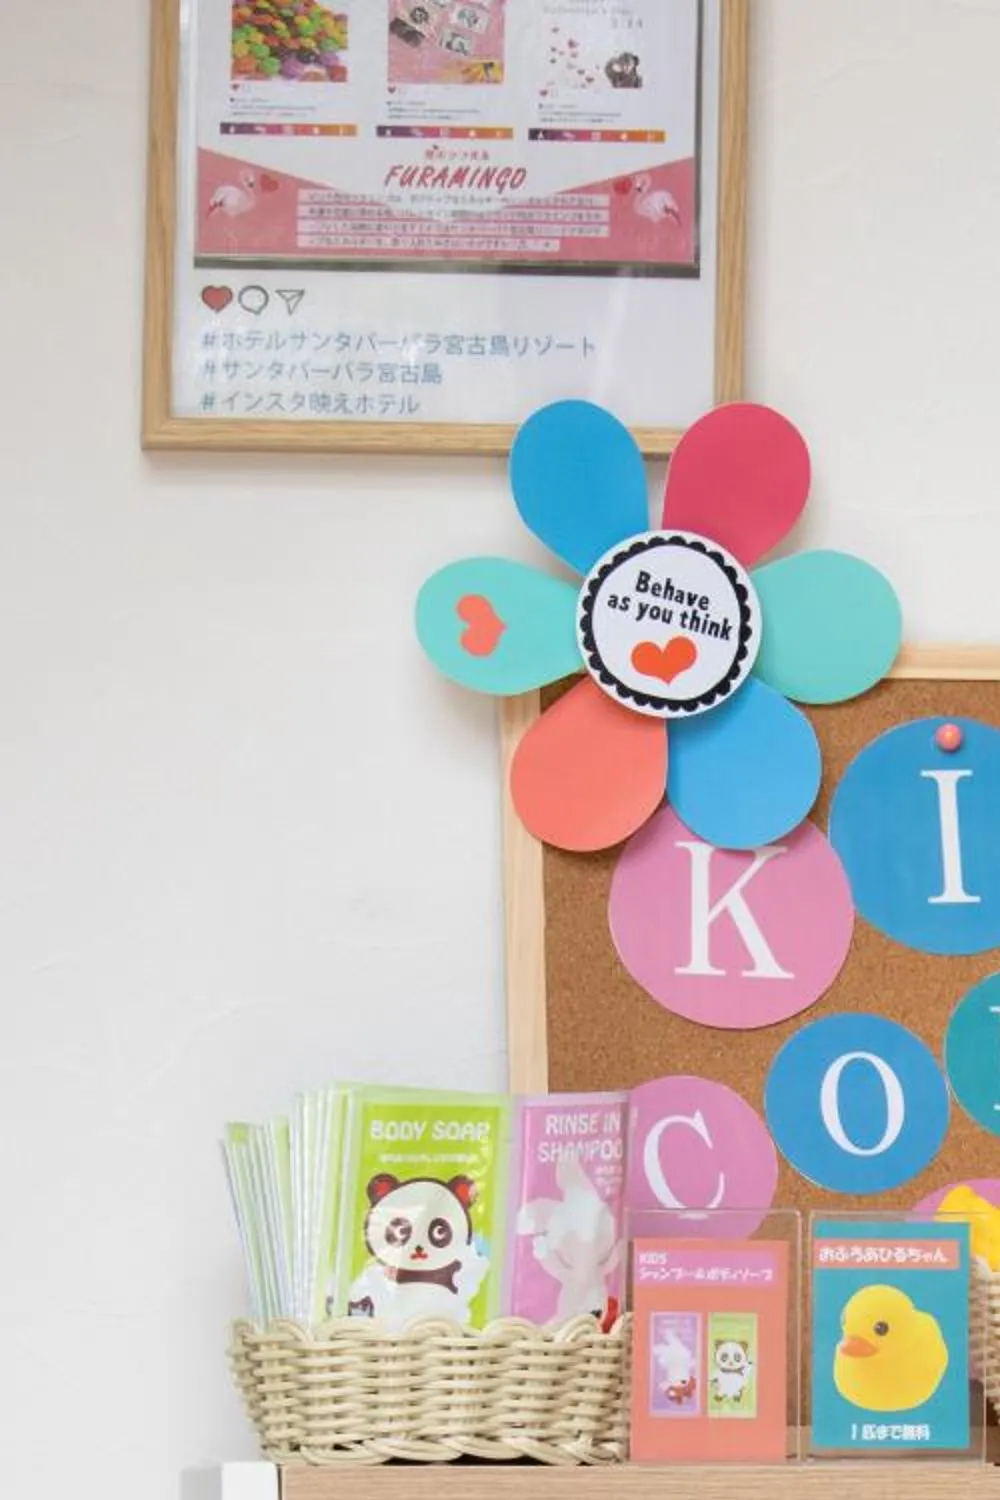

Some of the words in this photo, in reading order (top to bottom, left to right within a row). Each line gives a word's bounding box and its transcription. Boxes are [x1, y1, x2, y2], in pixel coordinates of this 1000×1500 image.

[384, 164, 527, 193] FURAMINGO
[635, 570, 710, 611] Behave
[607, 594, 631, 611] as
[635, 602, 673, 624] you
[680, 609, 733, 641] think
[370, 1120, 426, 1140] BODY
[431, 1120, 490, 1141] SOAP
[545, 1114, 599, 1135] RINSE
[602, 1113, 621, 1132] IN
